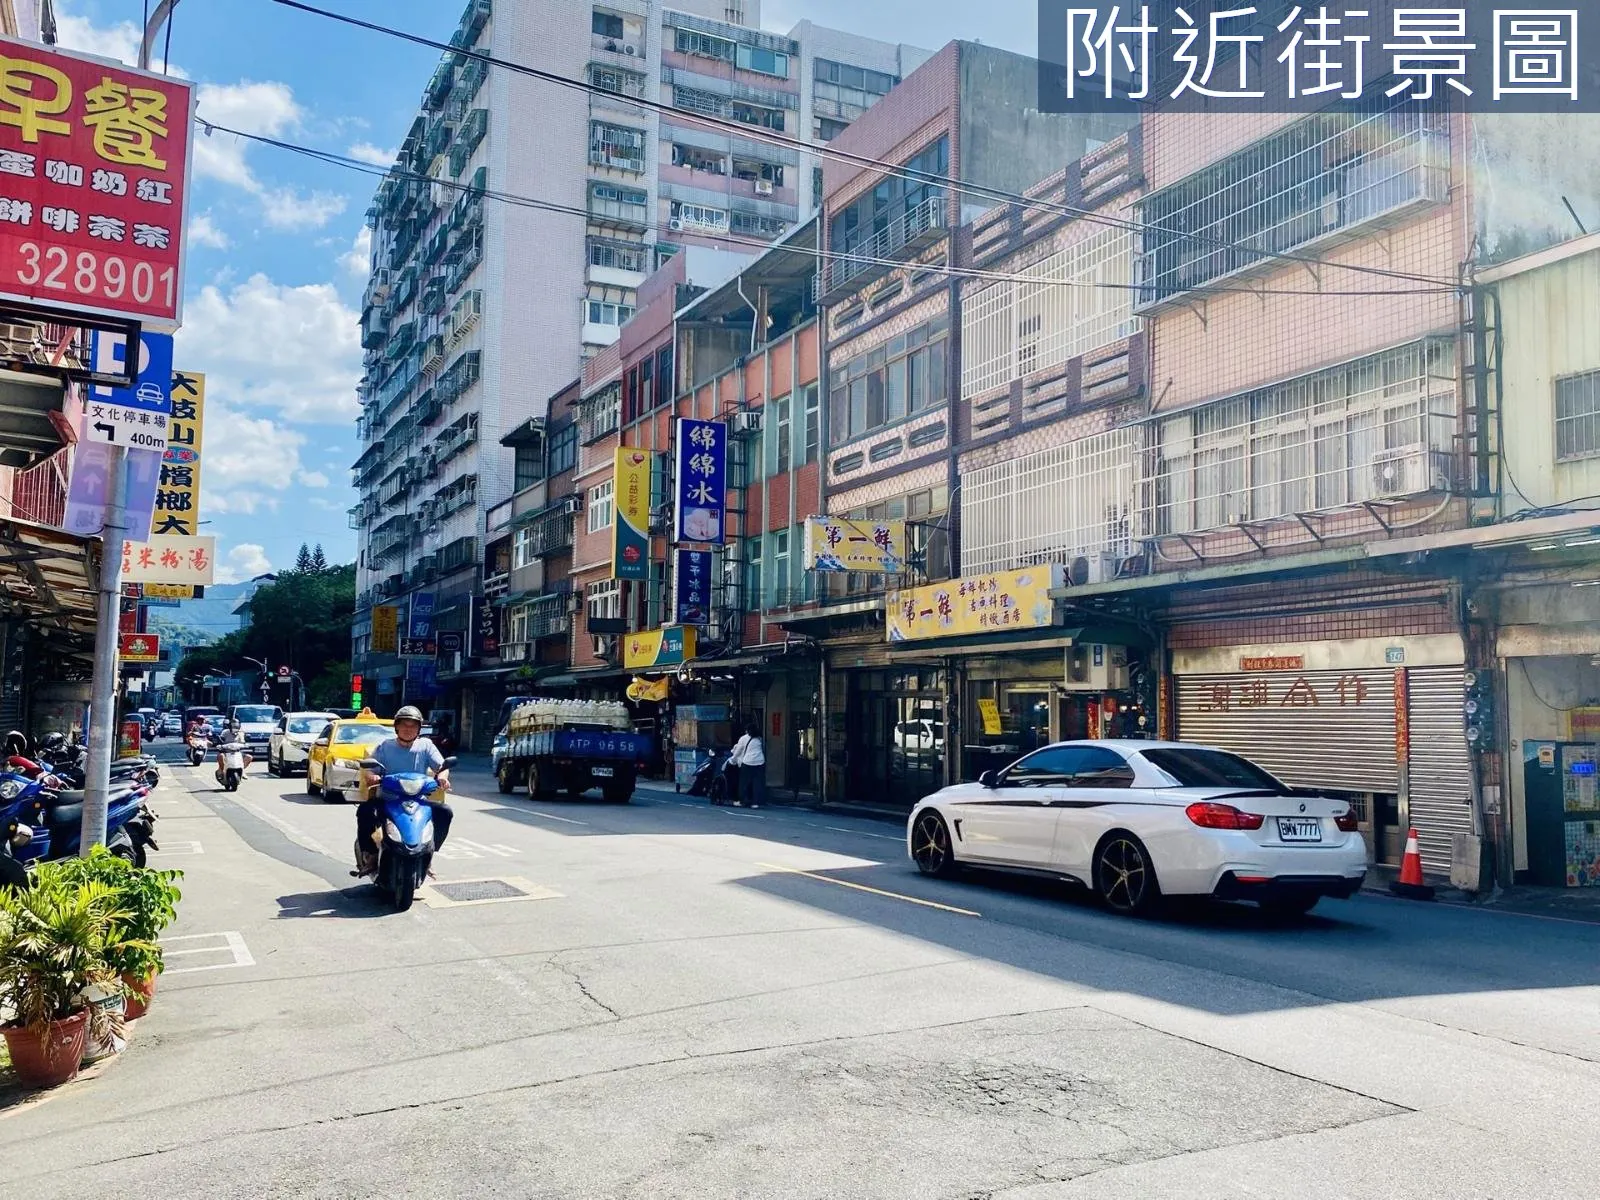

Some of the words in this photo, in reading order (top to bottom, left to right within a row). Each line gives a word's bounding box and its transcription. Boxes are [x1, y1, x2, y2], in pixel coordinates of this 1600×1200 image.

[0, 55, 168, 171] 早餐
[17, 242, 175, 307] 328901
[92, 404, 167, 429] 文化停車場
[130, 432, 165, 448] 400m
[687, 425, 717, 505] 綿綿冰
[825, 525, 892, 551] 第一鮮
[904, 594, 952, 628] 第一鮮
